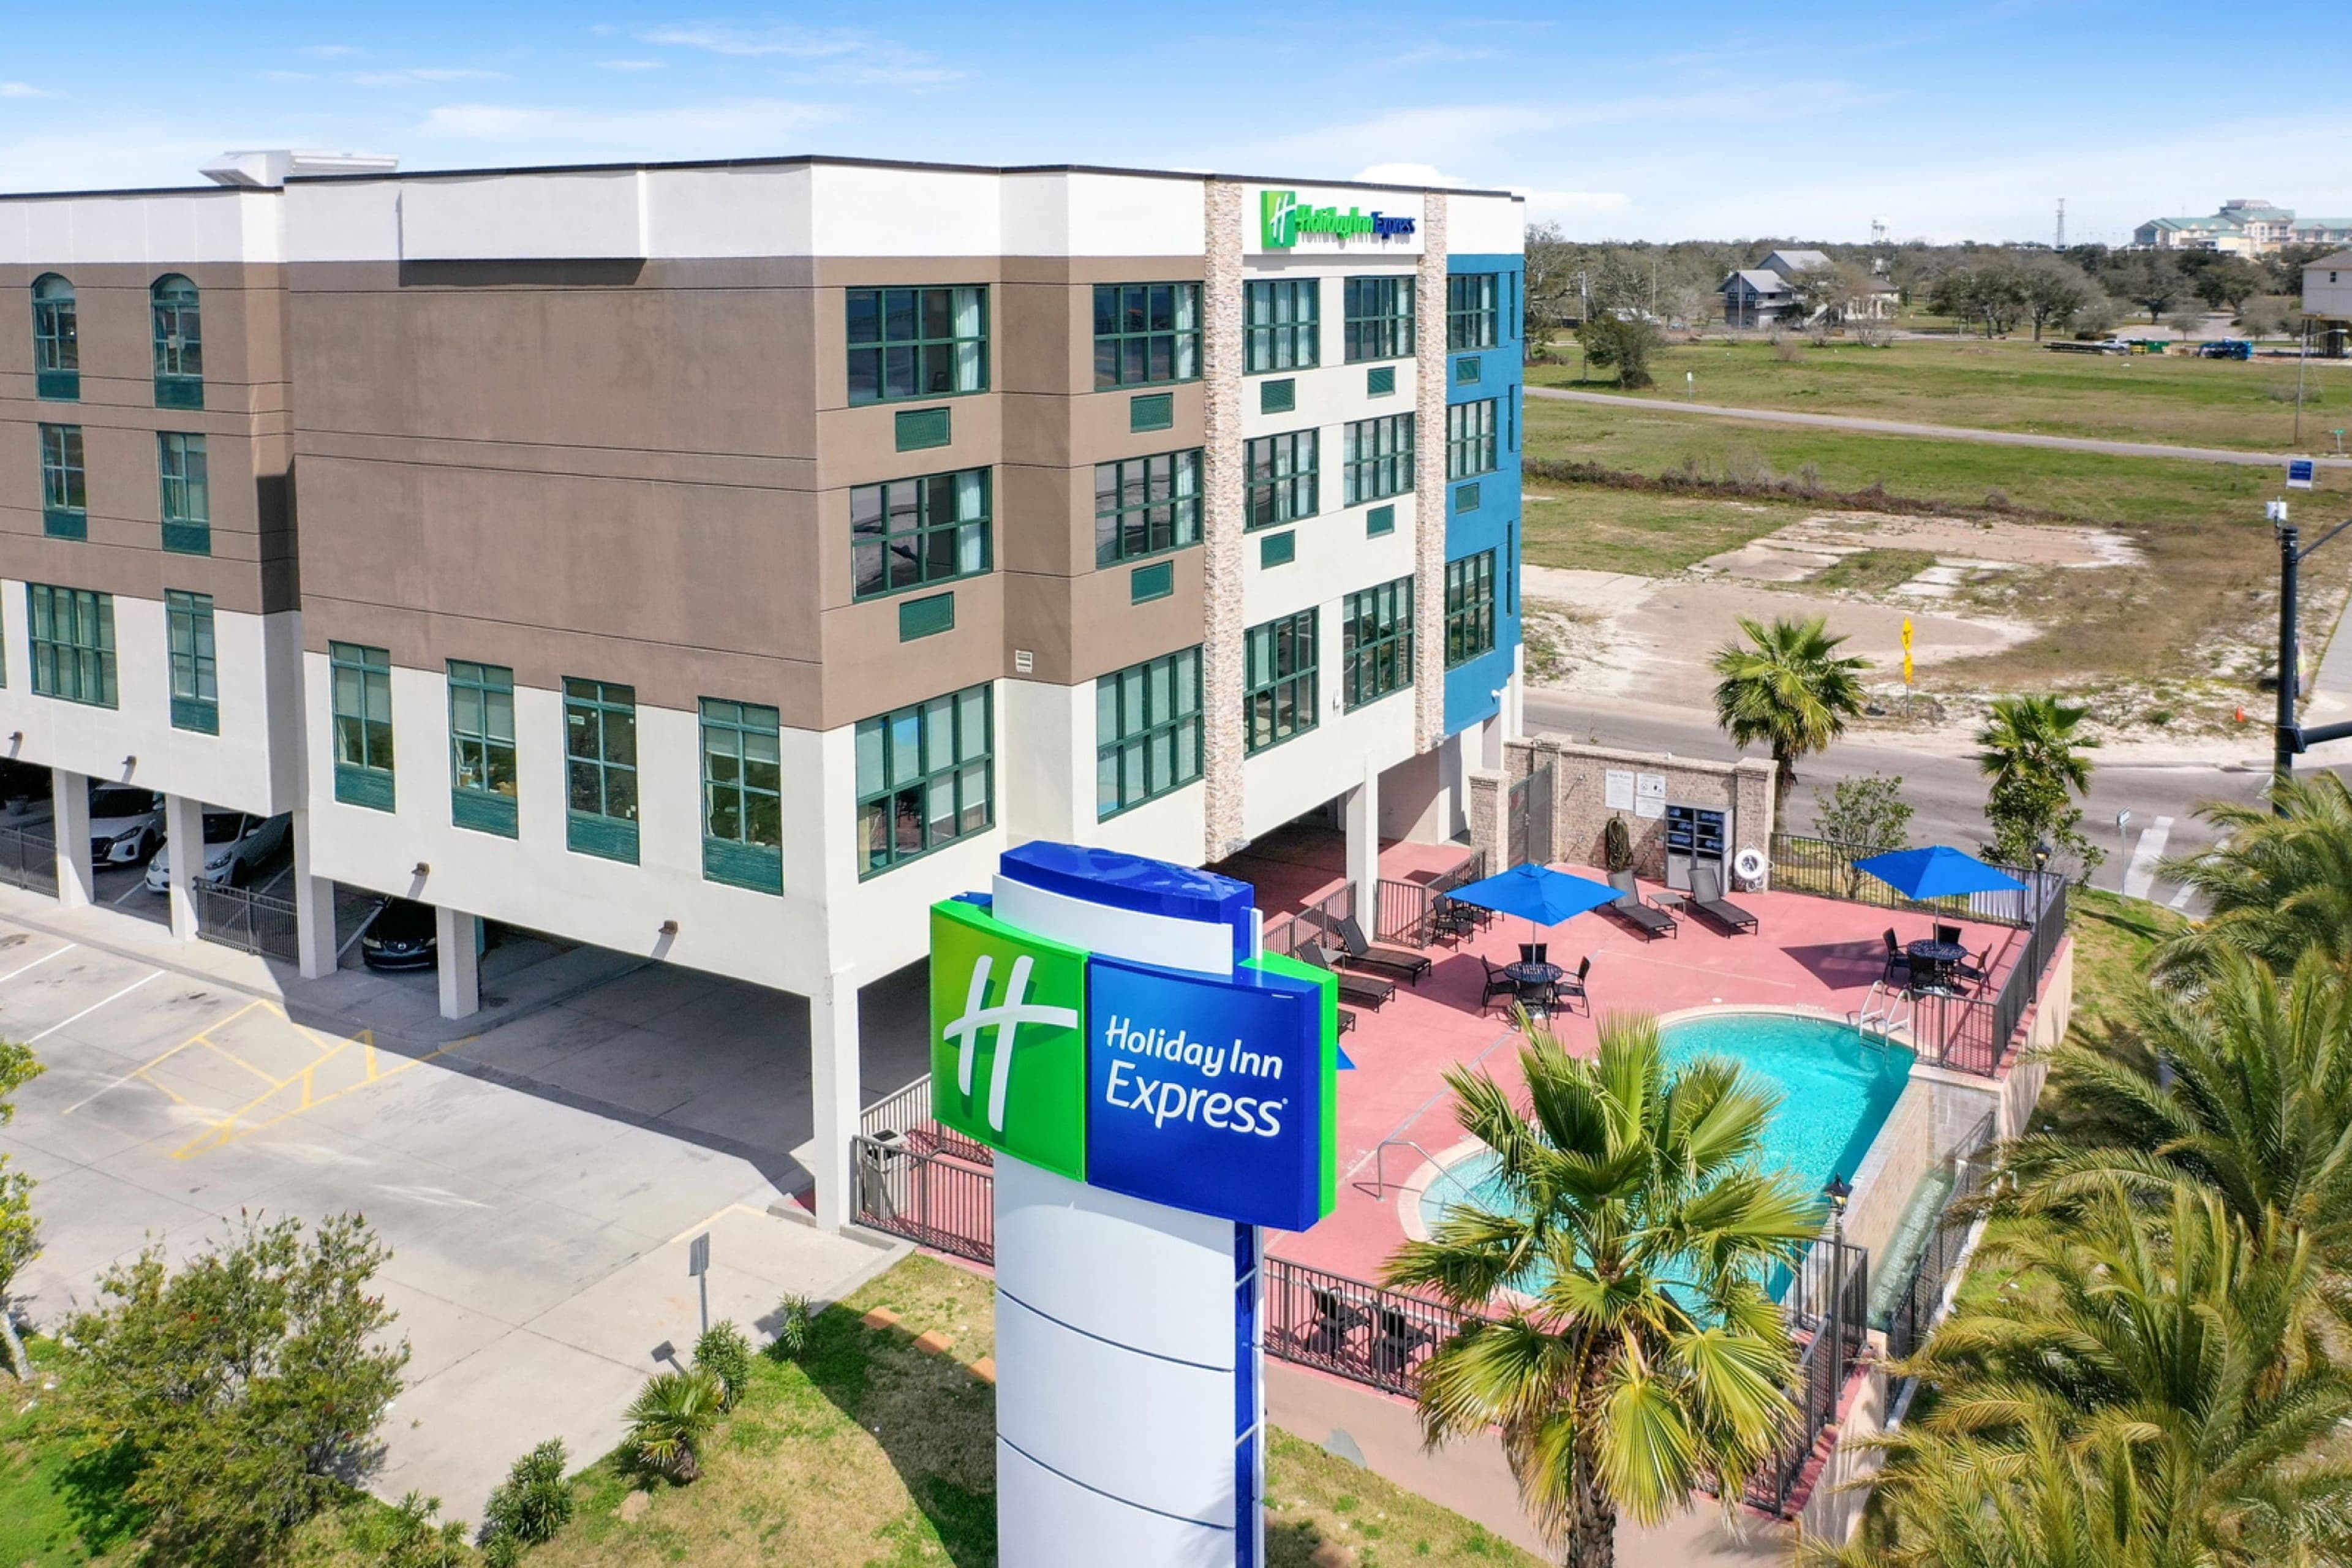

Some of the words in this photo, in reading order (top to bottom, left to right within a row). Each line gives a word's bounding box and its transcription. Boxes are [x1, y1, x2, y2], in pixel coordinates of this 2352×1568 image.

[1295, 204, 1351, 239] Holiday
[1349, 207, 1373, 233] Inn
[1371, 211, 1415, 239] Express
[1105, 1014, 1225, 1077] Holiday
[1229, 1038, 1283, 1080] Inn
[1106, 1059, 1283, 1137] Express
